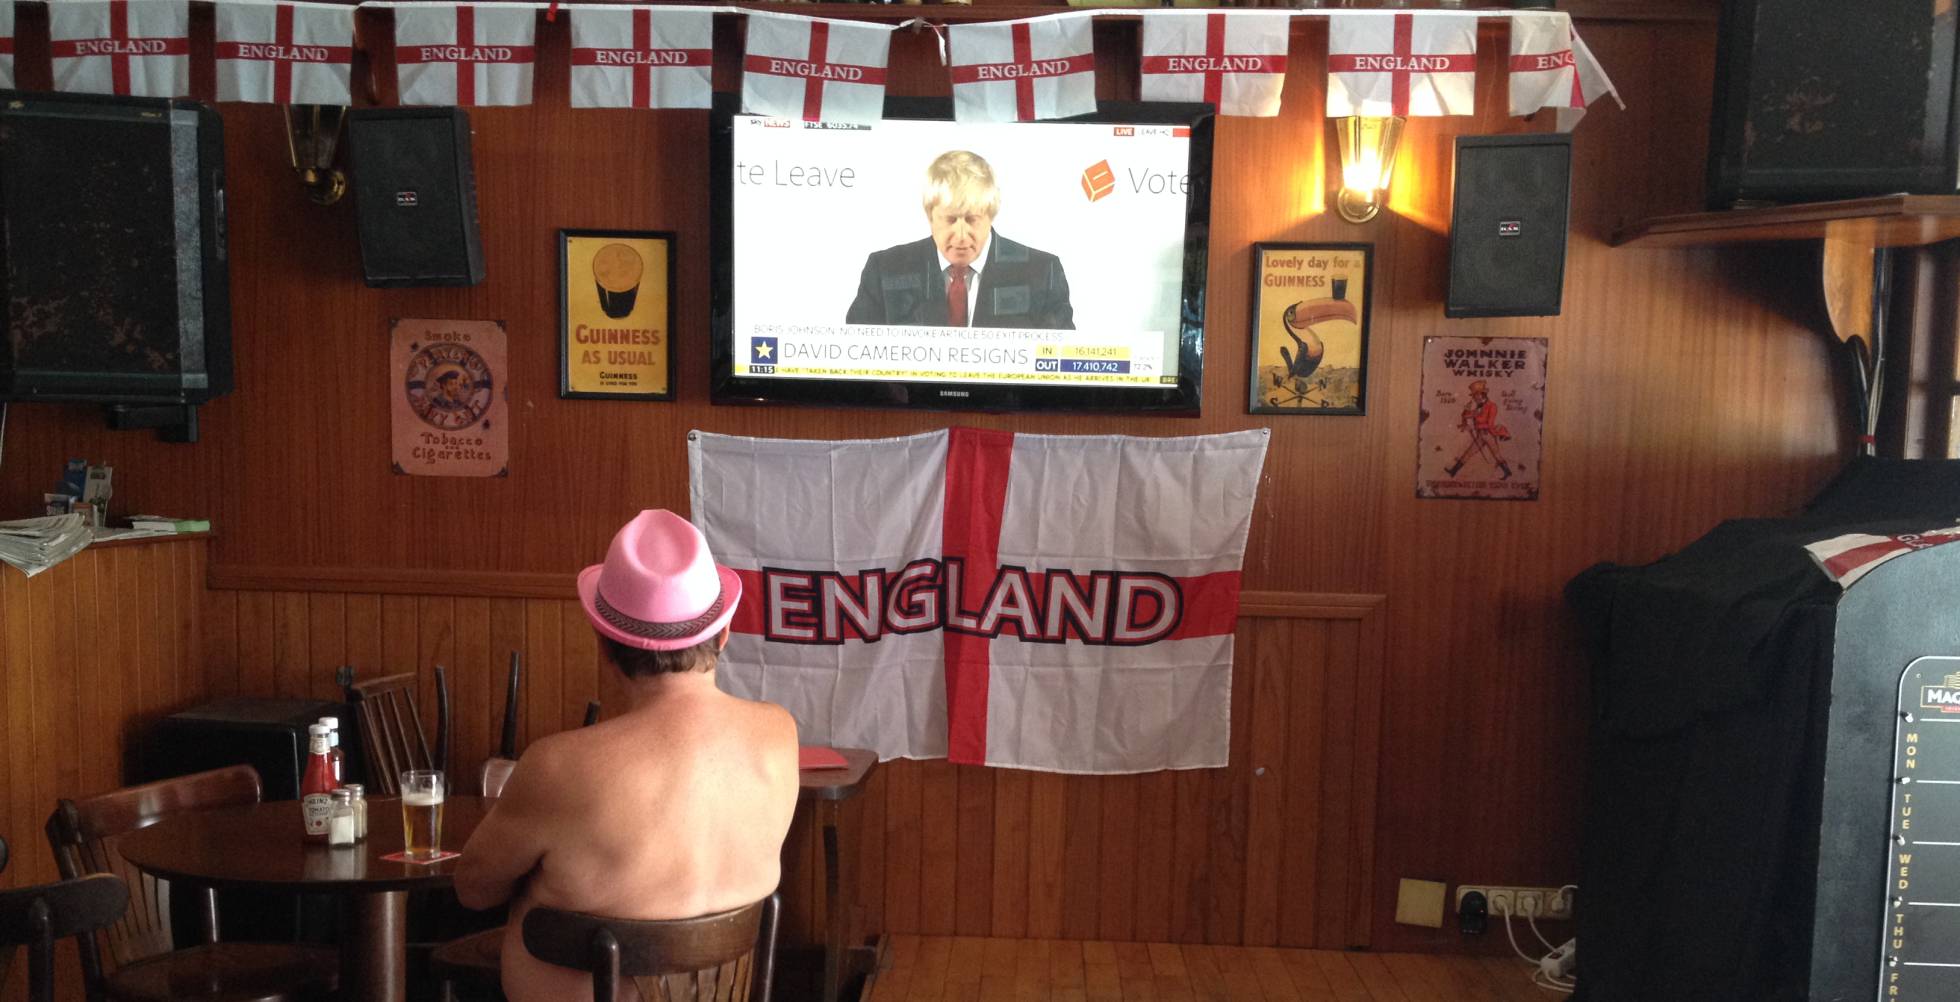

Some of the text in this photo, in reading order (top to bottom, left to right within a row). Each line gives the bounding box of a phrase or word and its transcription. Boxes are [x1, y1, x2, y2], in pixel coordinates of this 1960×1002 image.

[75, 40, 167, 55] ENGLAND
[238, 44, 328, 61] ENGLAND
[421, 47, 511, 61] ENGLAND
[595, 51, 688, 65] ENGLAND
[1167, 57, 1262, 72] ENGLAND
[1354, 56, 1450, 71] ENGLAND
[769, 60, 862, 81] ENGLAND
[977, 60, 1070, 80] ENGLAND
[1116, 128, 1132, 136] LIVE
[736, 160, 855, 187] te Leave
[1265, 256, 1304, 270] Lovely
[1308, 256, 1329, 270] day
[1333, 256, 1349, 268] for
[1264, 274, 1325, 288] GUINNESS
[424, 331, 472, 342] Smoke
[575, 324, 660, 345] GUINNESS
[858, 328, 884, 337] NEED
[582, 350, 655, 366] AS USUAL
[784, 343, 1028, 365] DAVID CAMERON RESIGNS
[1042, 347, 1052, 356] IN
[1444, 349, 1526, 359] JOHNNIE
[751, 365, 774, 374] 11:15
[1037, 360, 1057, 370] OUT
[1444, 359, 1526, 370] WALKER
[600, 371, 638, 380] GUINNESS
[1453, 369, 1513, 377] WHISKY
[420, 431, 483, 446] Tobacco
[412, 446, 492, 464] Cigarettes
[763, 557, 1183, 646] ENGLAND
[1906, 733, 1919, 769] MON
[1902, 793, 1912, 830] TUE
[1899, 854, 1912, 889] WED
[1893, 913, 1904, 949] THU
